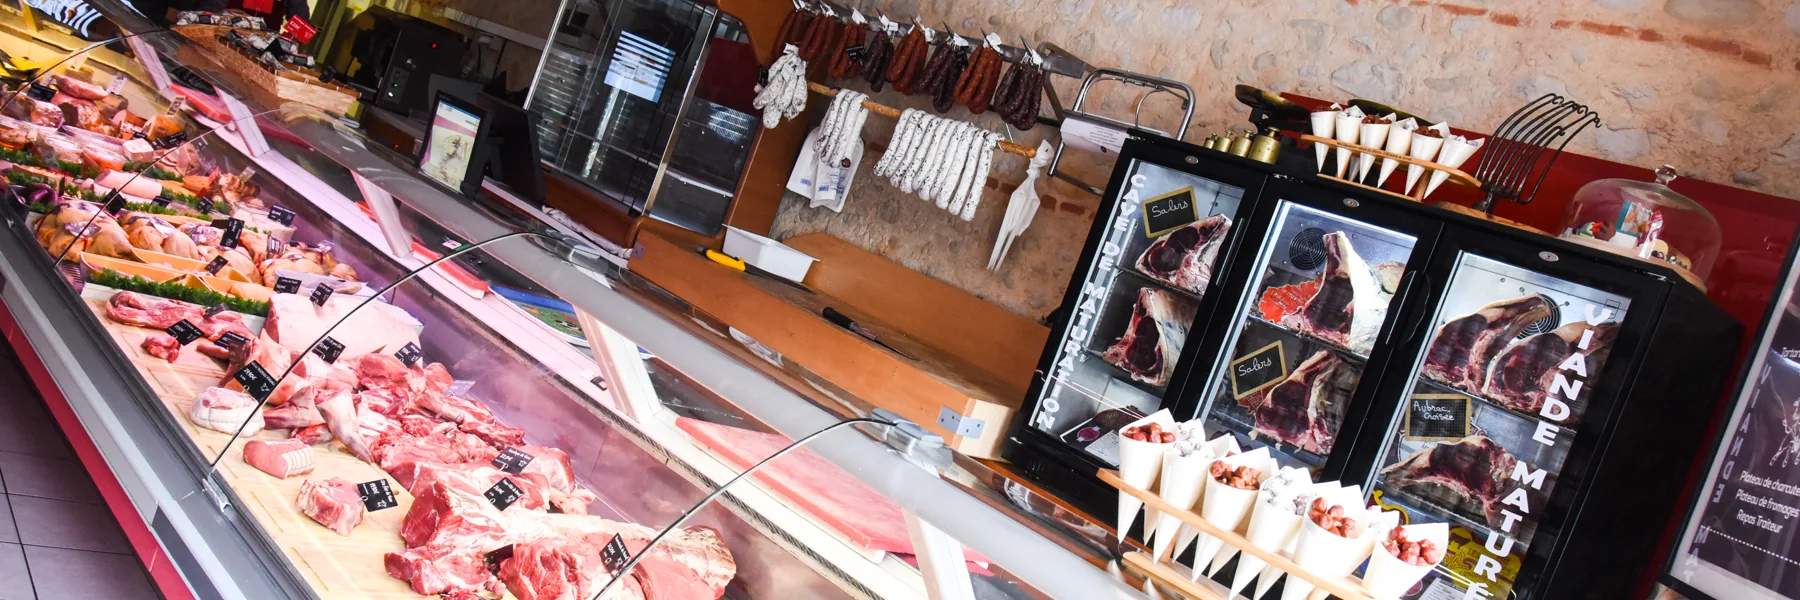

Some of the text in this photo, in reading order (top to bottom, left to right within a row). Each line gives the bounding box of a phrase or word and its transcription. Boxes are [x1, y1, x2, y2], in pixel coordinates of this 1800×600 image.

[1114, 174, 1147, 232] CAVE
[1151, 199, 1189, 218] Salers
[1098, 241, 1120, 272] DE
[1036, 282, 1106, 430] MATURATION
[1238, 357, 1272, 377] Salers
[1532, 303, 1612, 447] VIANDE
[1740, 470, 1763, 486] Plateau
[1763, 477, 1772, 488] de
[1735, 489, 1799, 519] Plateau de fromages
[1736, 509, 1783, 533] Repas Traiteur
